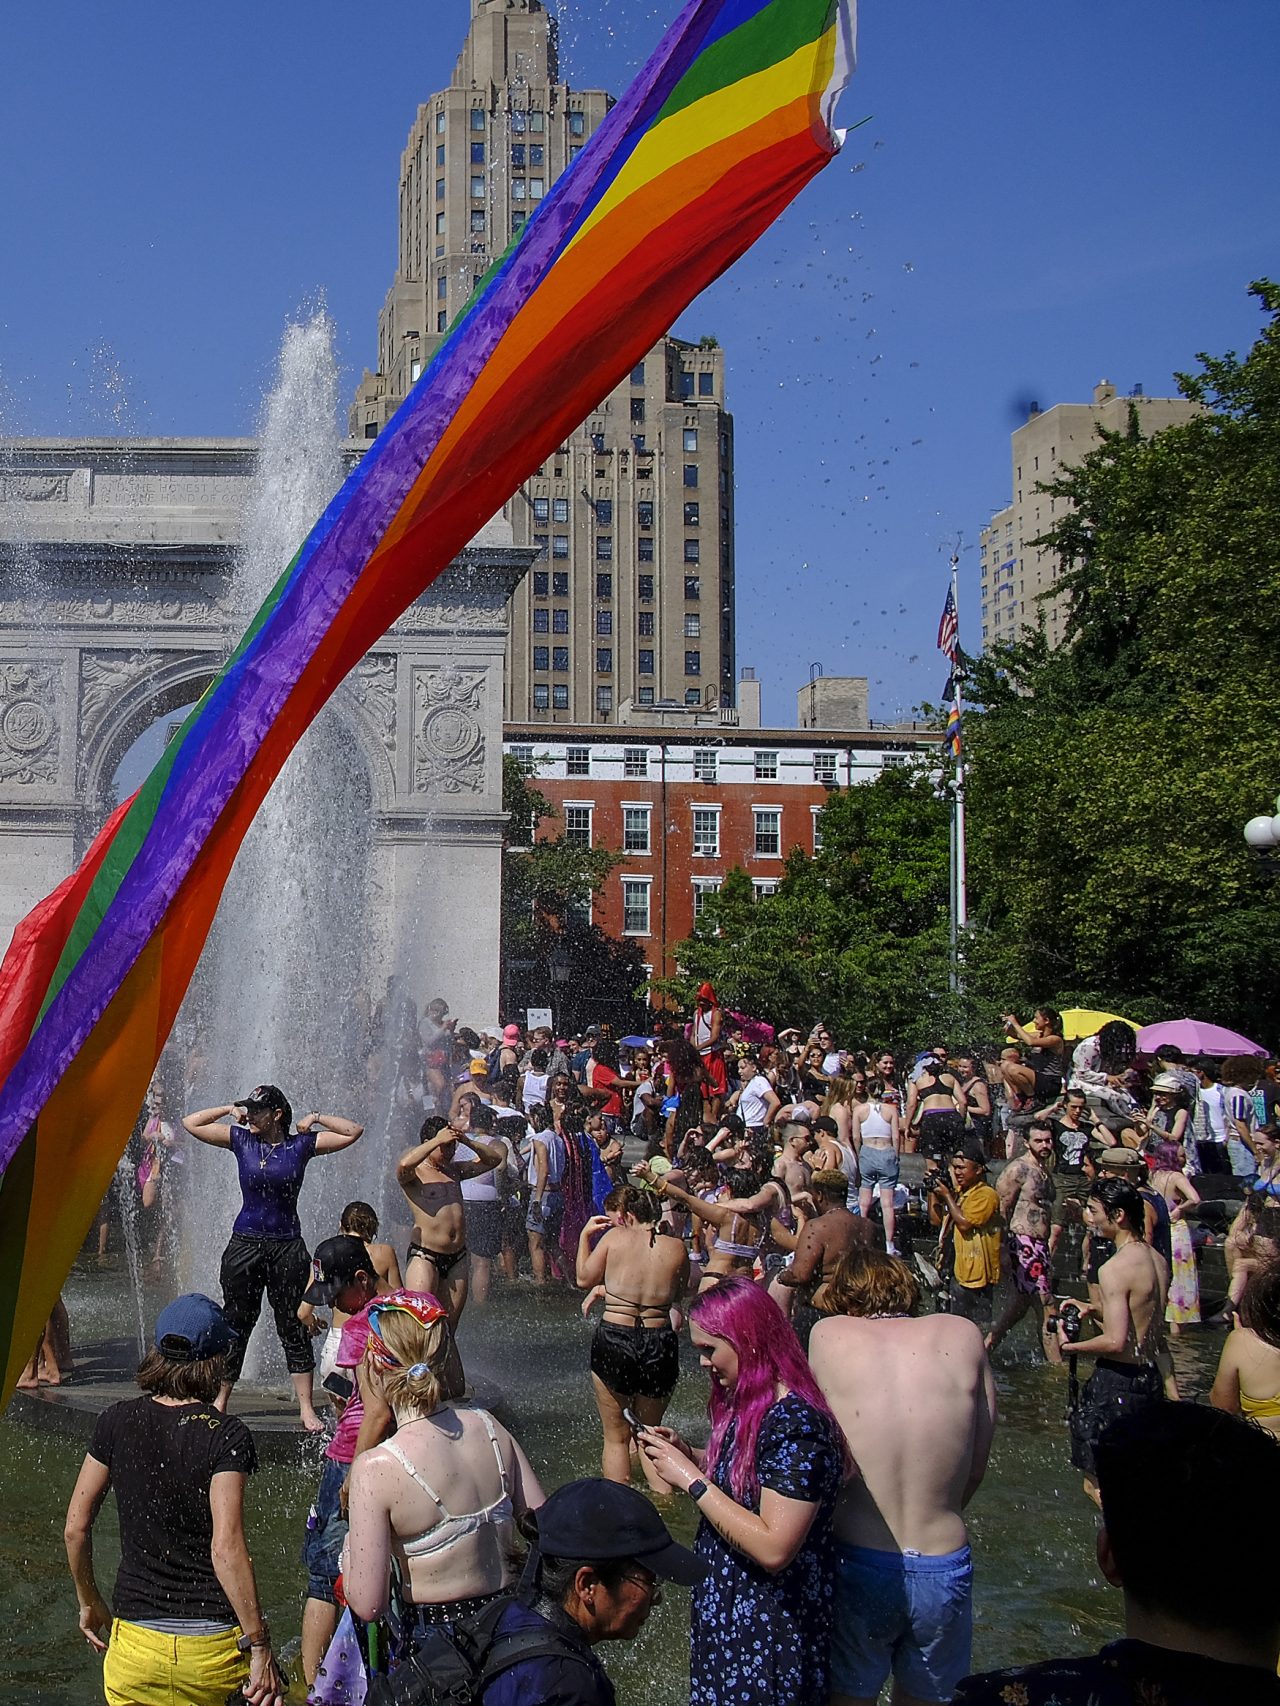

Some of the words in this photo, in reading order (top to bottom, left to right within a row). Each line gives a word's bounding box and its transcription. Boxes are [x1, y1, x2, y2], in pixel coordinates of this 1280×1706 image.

[159, 483, 208, 493] HONEST
[160, 493, 195, 503] HAND
[200, 493, 216, 503] OF
